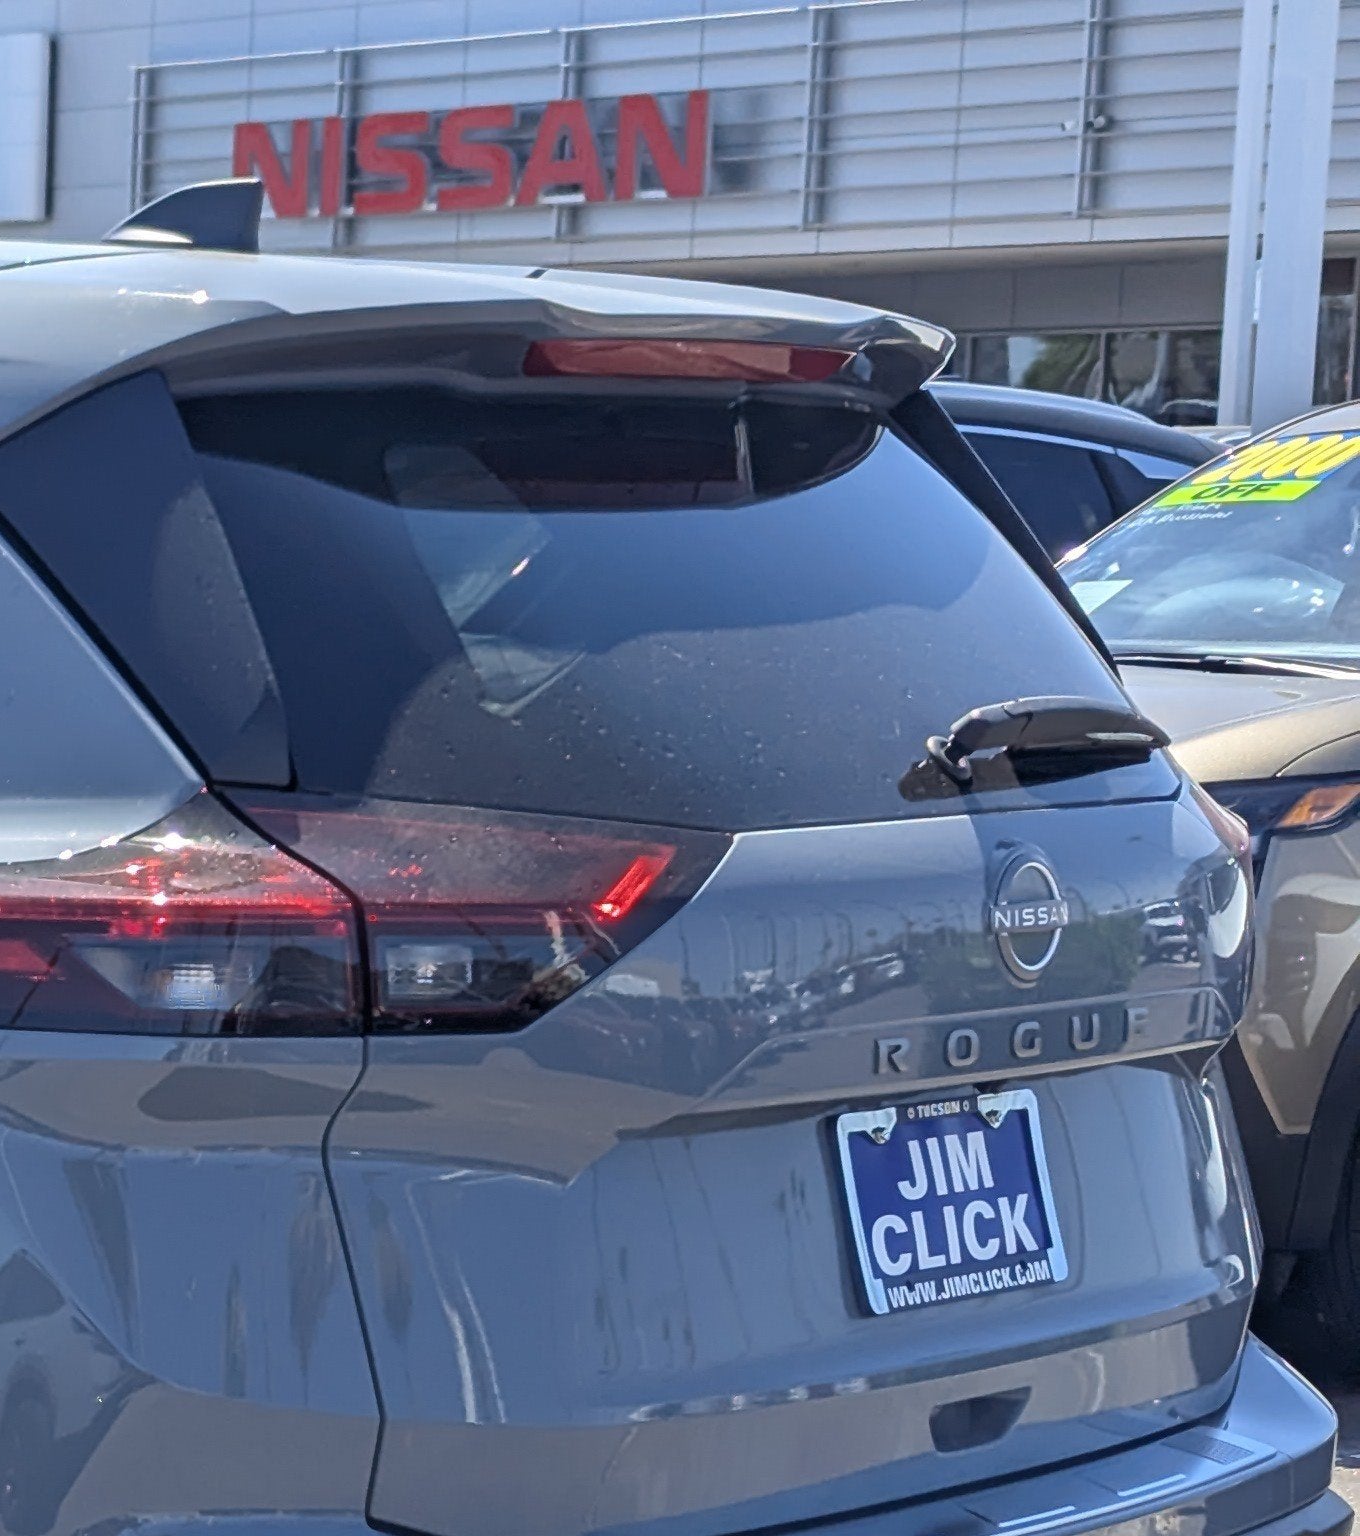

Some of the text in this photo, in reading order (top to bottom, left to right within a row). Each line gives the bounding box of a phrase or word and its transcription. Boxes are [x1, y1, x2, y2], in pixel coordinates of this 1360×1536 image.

[232, 89, 709, 219] NISSAN
[1190, 482, 1282, 500] OFF
[993, 903, 1069, 929] NISSAN
[897, 1130, 995, 1201] JIM
[871, 1193, 1040, 1277] CLICK
[887, 1259, 1051, 1309] WWW.JIMCLICK.COM
